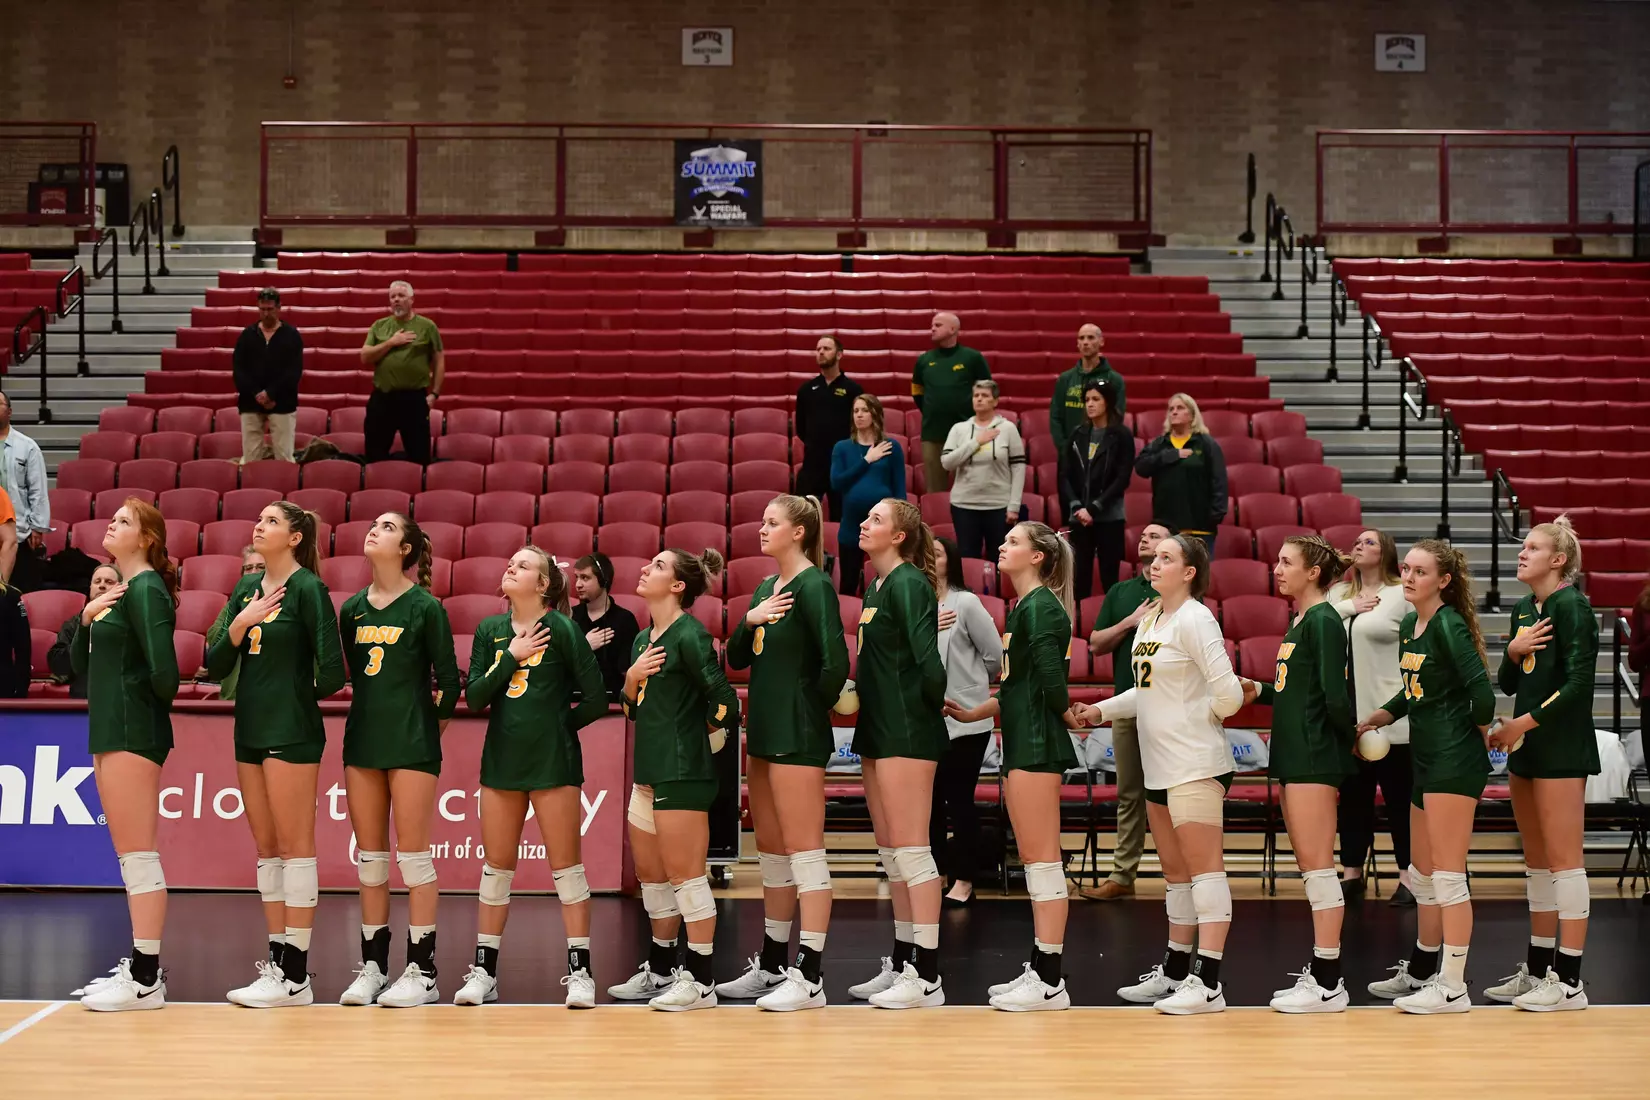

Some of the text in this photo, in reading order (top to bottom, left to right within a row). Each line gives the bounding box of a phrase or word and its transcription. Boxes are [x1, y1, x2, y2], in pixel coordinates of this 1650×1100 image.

[682, 161, 756, 177] SUMMIT
[247, 625, 263, 655] 2
[354, 625, 405, 645] NDSU
[752, 625, 766, 656] 8
[364, 646, 385, 676] 3
[1133, 660, 1153, 689] 12
[505, 668, 530, 699] 5
[454, 836, 472, 859] of
